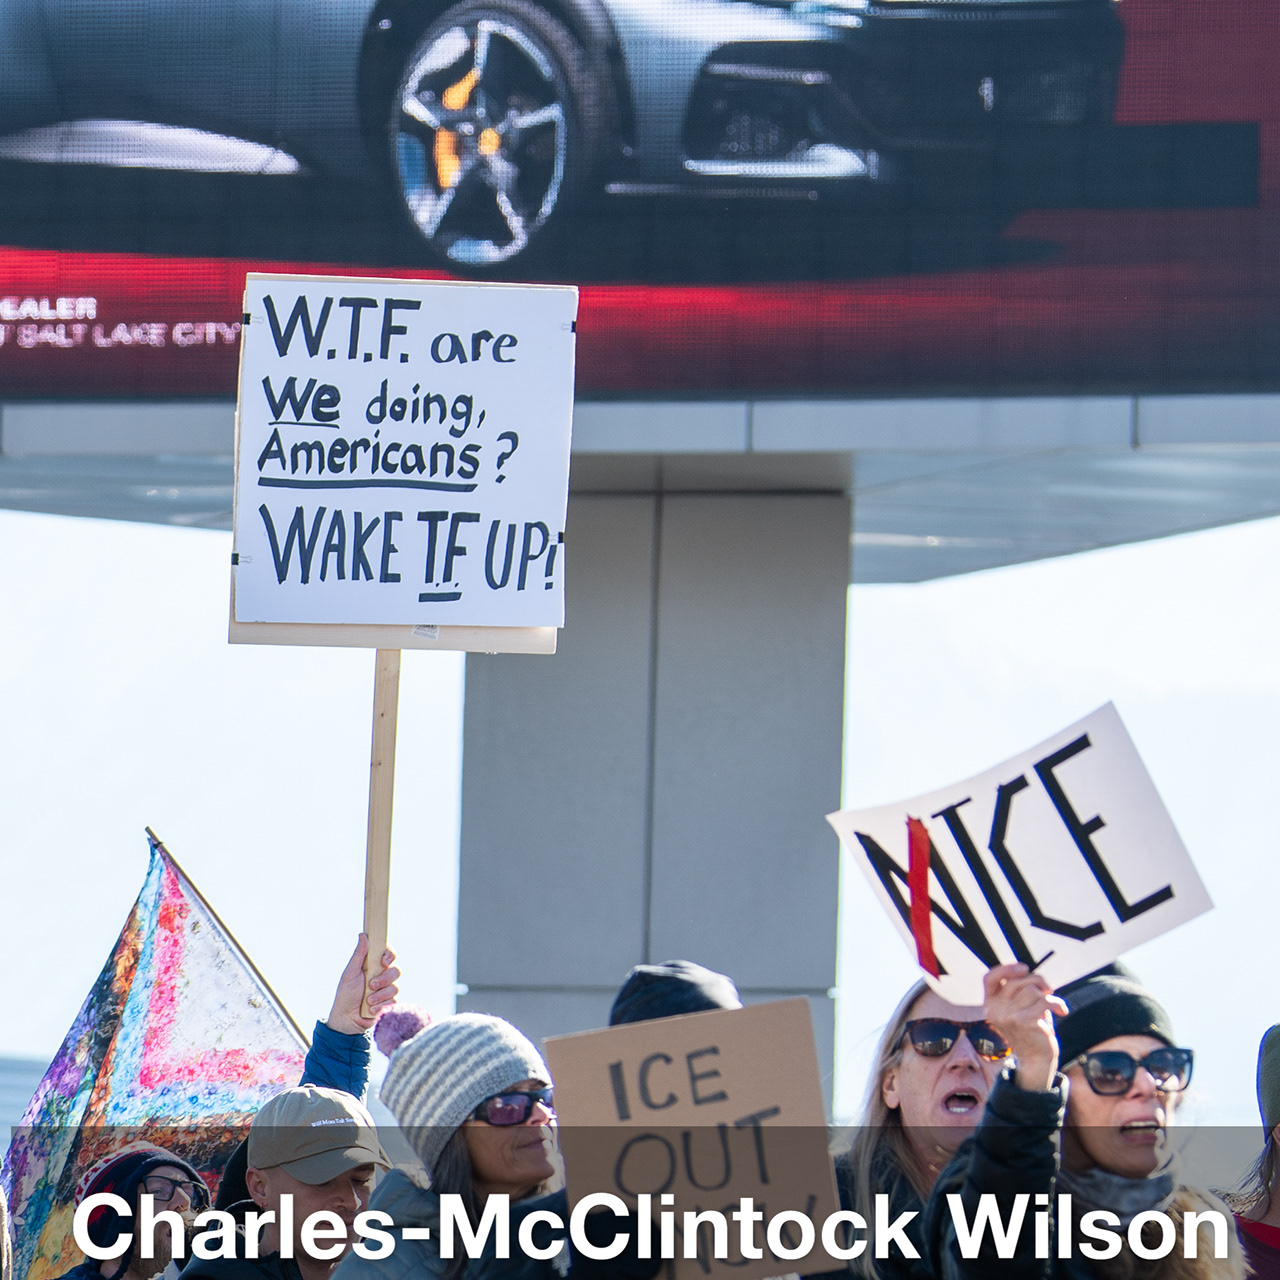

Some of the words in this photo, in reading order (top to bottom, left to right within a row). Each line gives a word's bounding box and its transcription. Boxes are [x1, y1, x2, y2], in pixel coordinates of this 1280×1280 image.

[17, 323, 87, 348] SALT
[92, 322, 168, 347] LAKE
[173, 322, 241, 347] CITY
[262, 294, 423, 364] W.T.F.
[430, 329, 519, 364] are
[261, 375, 342, 423] We
[365, 377, 487, 439] doing,
[258, 503, 404, 585] WAKE
[484, 519, 558, 591] UP!
[608, 1045, 729, 1122] ICE
[614, 1105, 782, 1199] OUT
